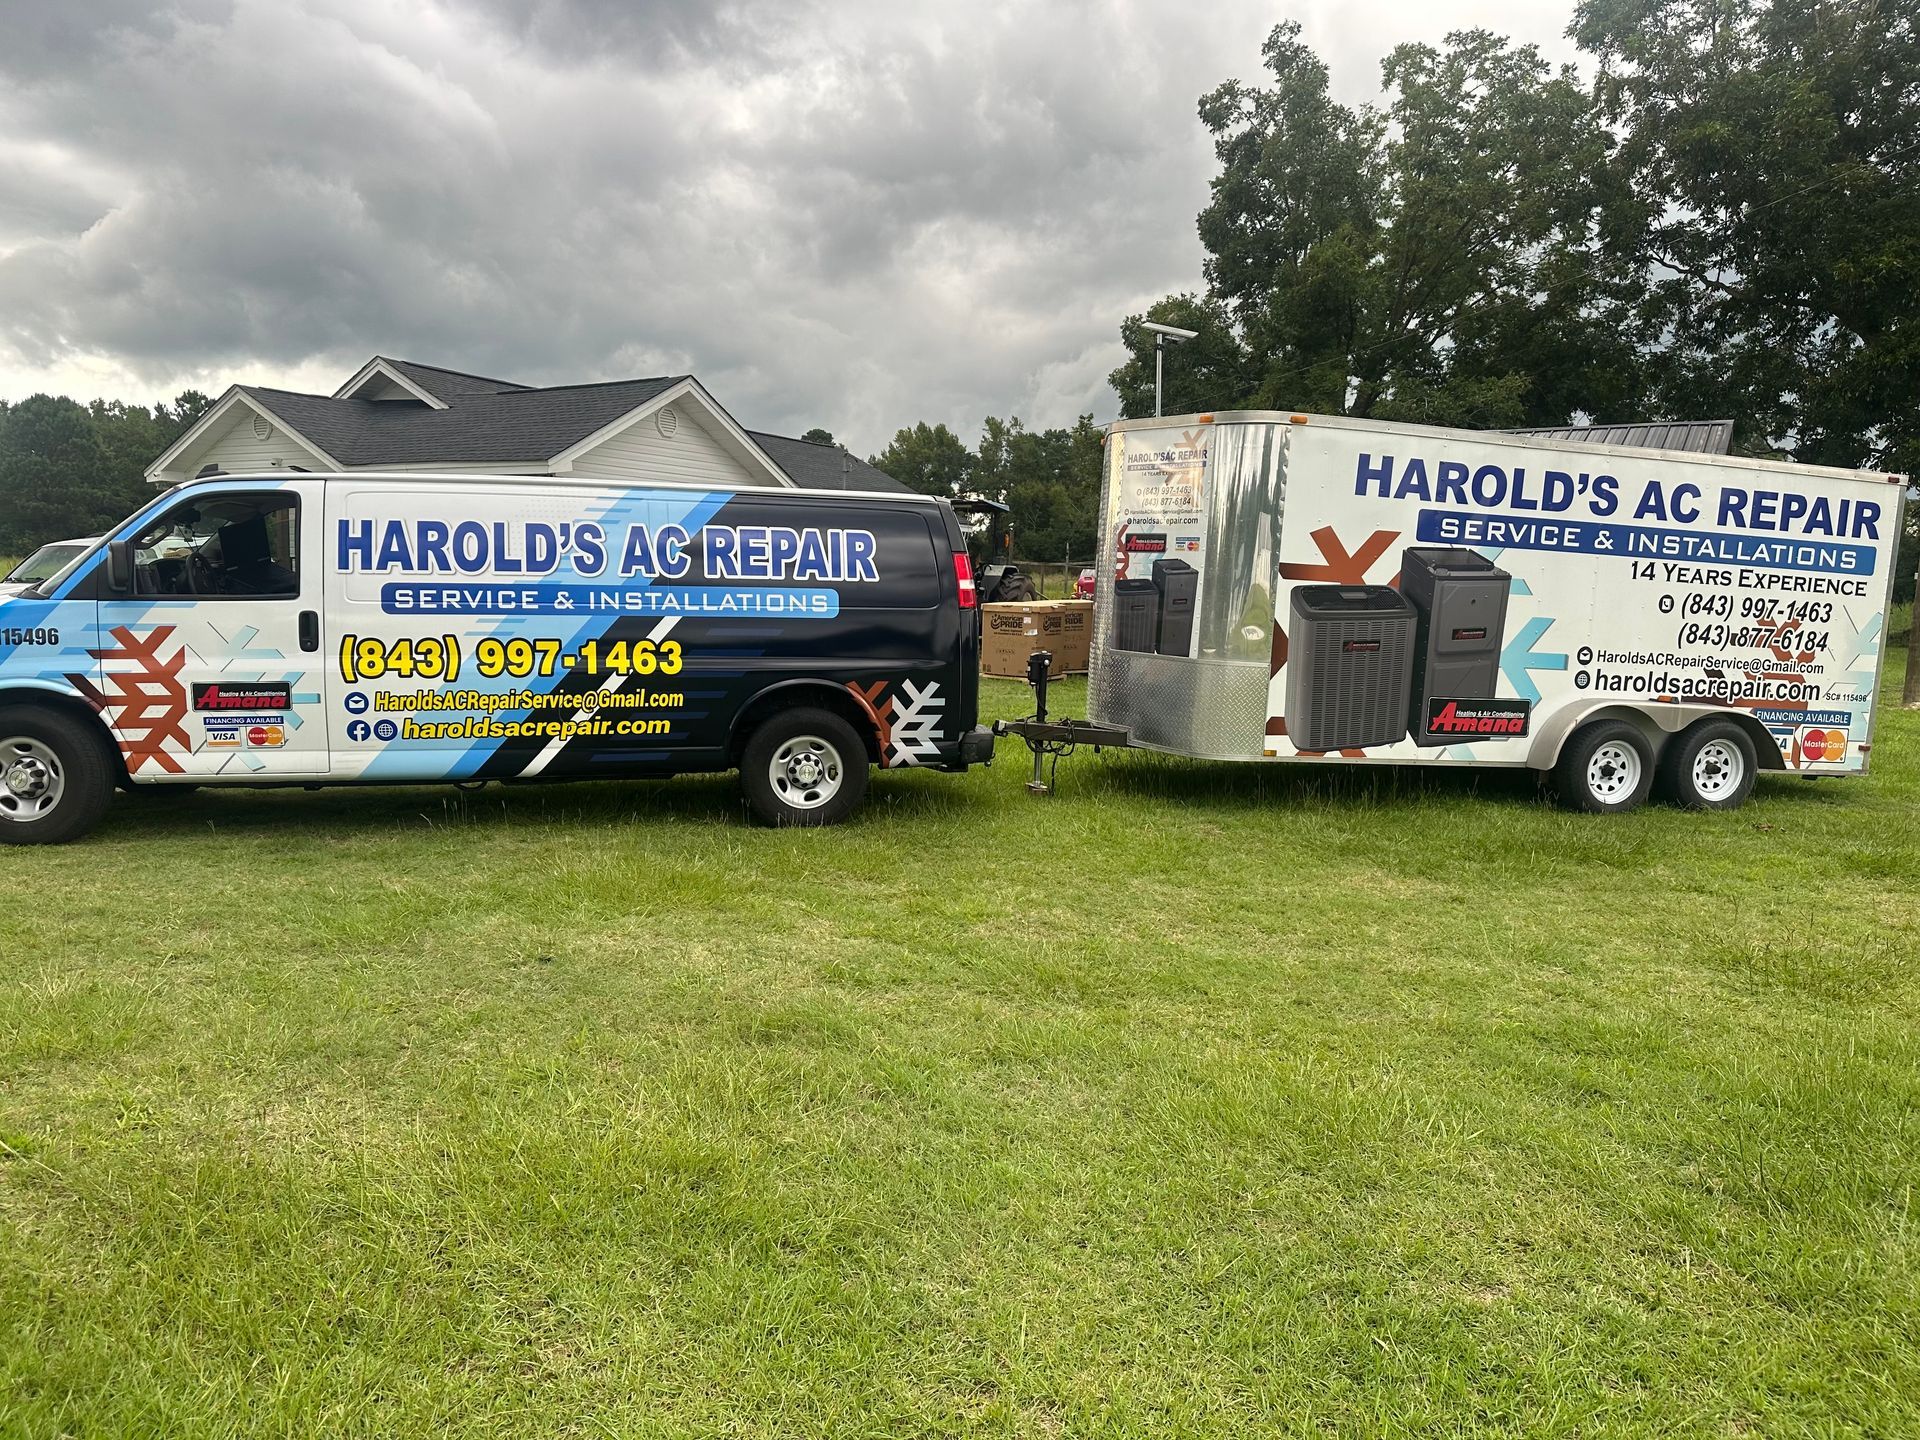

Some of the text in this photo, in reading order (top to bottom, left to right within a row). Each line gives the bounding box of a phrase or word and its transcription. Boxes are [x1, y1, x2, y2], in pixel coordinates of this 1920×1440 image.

[1178, 449, 1208, 461] REPAIR
[1161, 485, 1192, 495] 997-1463
[1354, 453, 1881, 541] HAROLD'S AC REPAIR
[1160, 497, 1191, 507] 877-6184
[1132, 517, 1199, 526] haroldsacepair.com
[337, 519, 878, 580] HAROLD'S AC REPAIR
[1127, 536, 1164, 551] Amana
[1440, 518, 1857, 569] SERVICE & INSTALLATIONS
[1631, 561, 1656, 581] 14
[395, 589, 828, 612] SERVICE & INSTALLATIONS
[1681, 593, 1833, 624] (843) 997-1463
[0, 627, 59, 646] 15496
[1000, 621, 1023, 629] PRIDE
[1677, 622, 1829, 653] (843) 877-6184
[339, 634, 684, 682] (843) 997-1463
[1597, 650, 1824, 675] HaroldsACRepairService@Gmail.com
[196, 685, 287, 708] Amana
[1595, 669, 1820, 702] haroldsacrepair.com
[1826, 692, 1866, 702] SC# 115496
[374, 688, 684, 713] HaroldsACRepairService@Gmail.com
[1430, 701, 1524, 732] Amana
[1756, 710, 1849, 724] FINANCING AVAILABLE
[402, 717, 671, 740] haroldsacrepair.com
[1804, 741, 1844, 749] MasterCard
